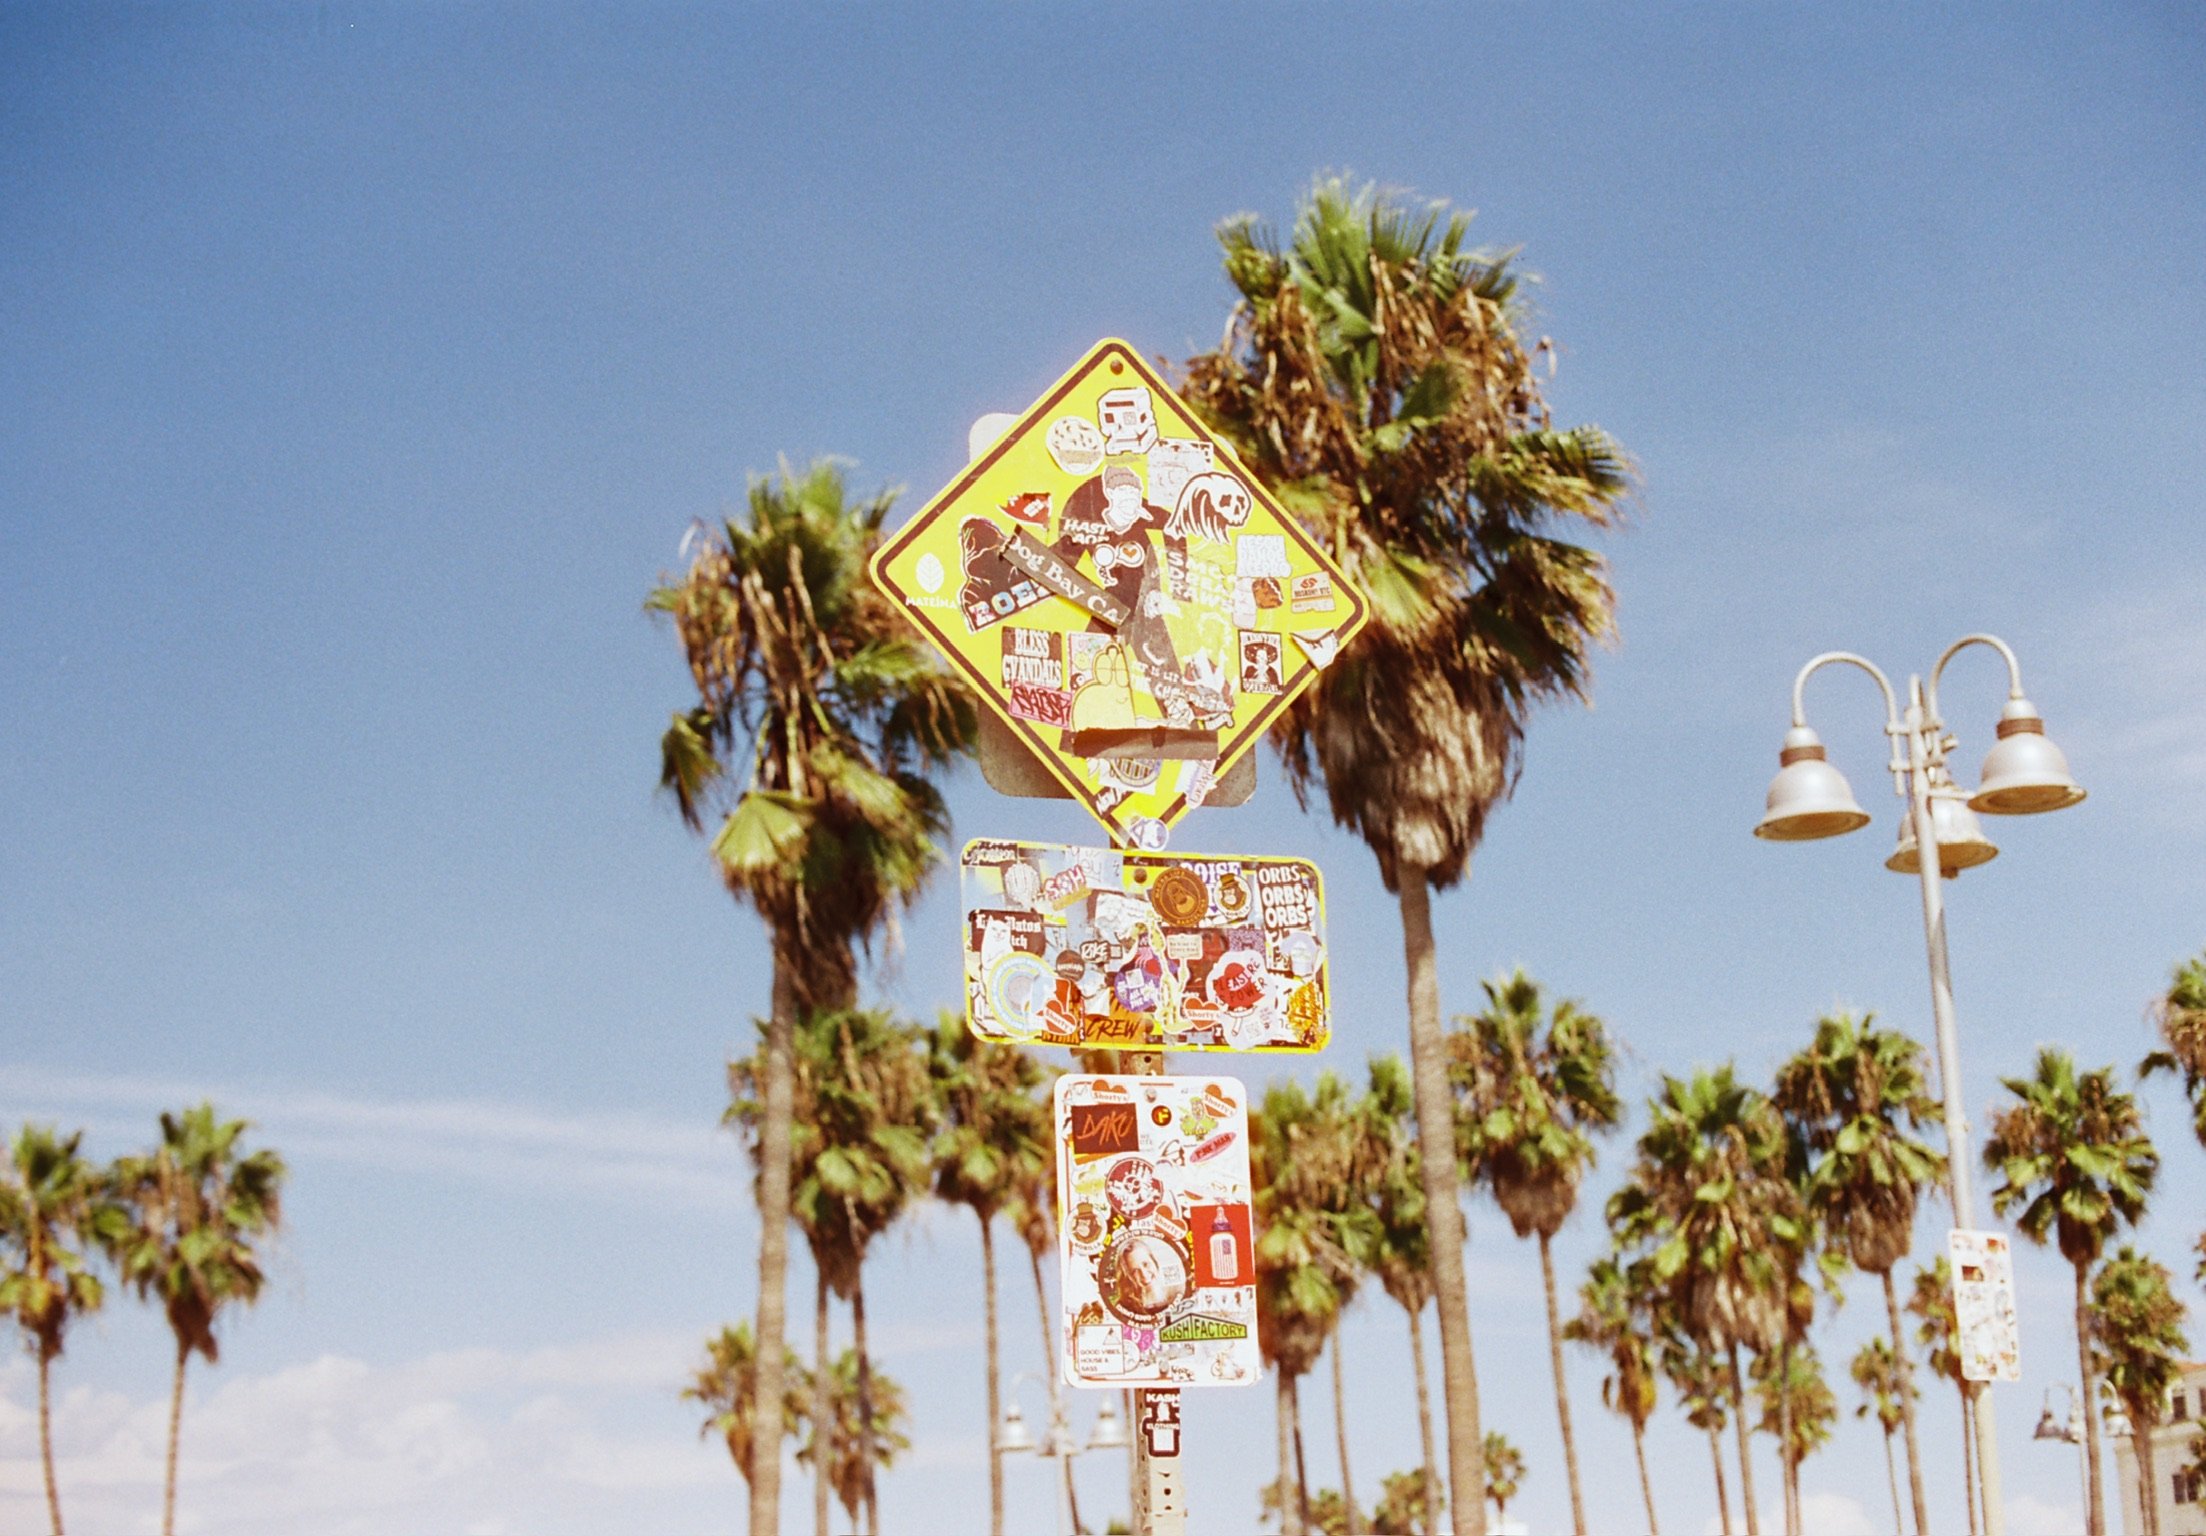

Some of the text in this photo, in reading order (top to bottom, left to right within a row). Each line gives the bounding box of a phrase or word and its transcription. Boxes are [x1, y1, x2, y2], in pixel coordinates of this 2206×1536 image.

[1045, 561, 1085, 599] Bay
[1259, 865, 1300, 884] ORBS
[1261, 885, 1304, 907] ORBS
[1265, 905, 1309, 928] ORBS
[1087, 1018, 1140, 1042] CREW
[1162, 1318, 1244, 1339] KUSH FACTORY
[1146, 1393, 1181, 1402] KASH
